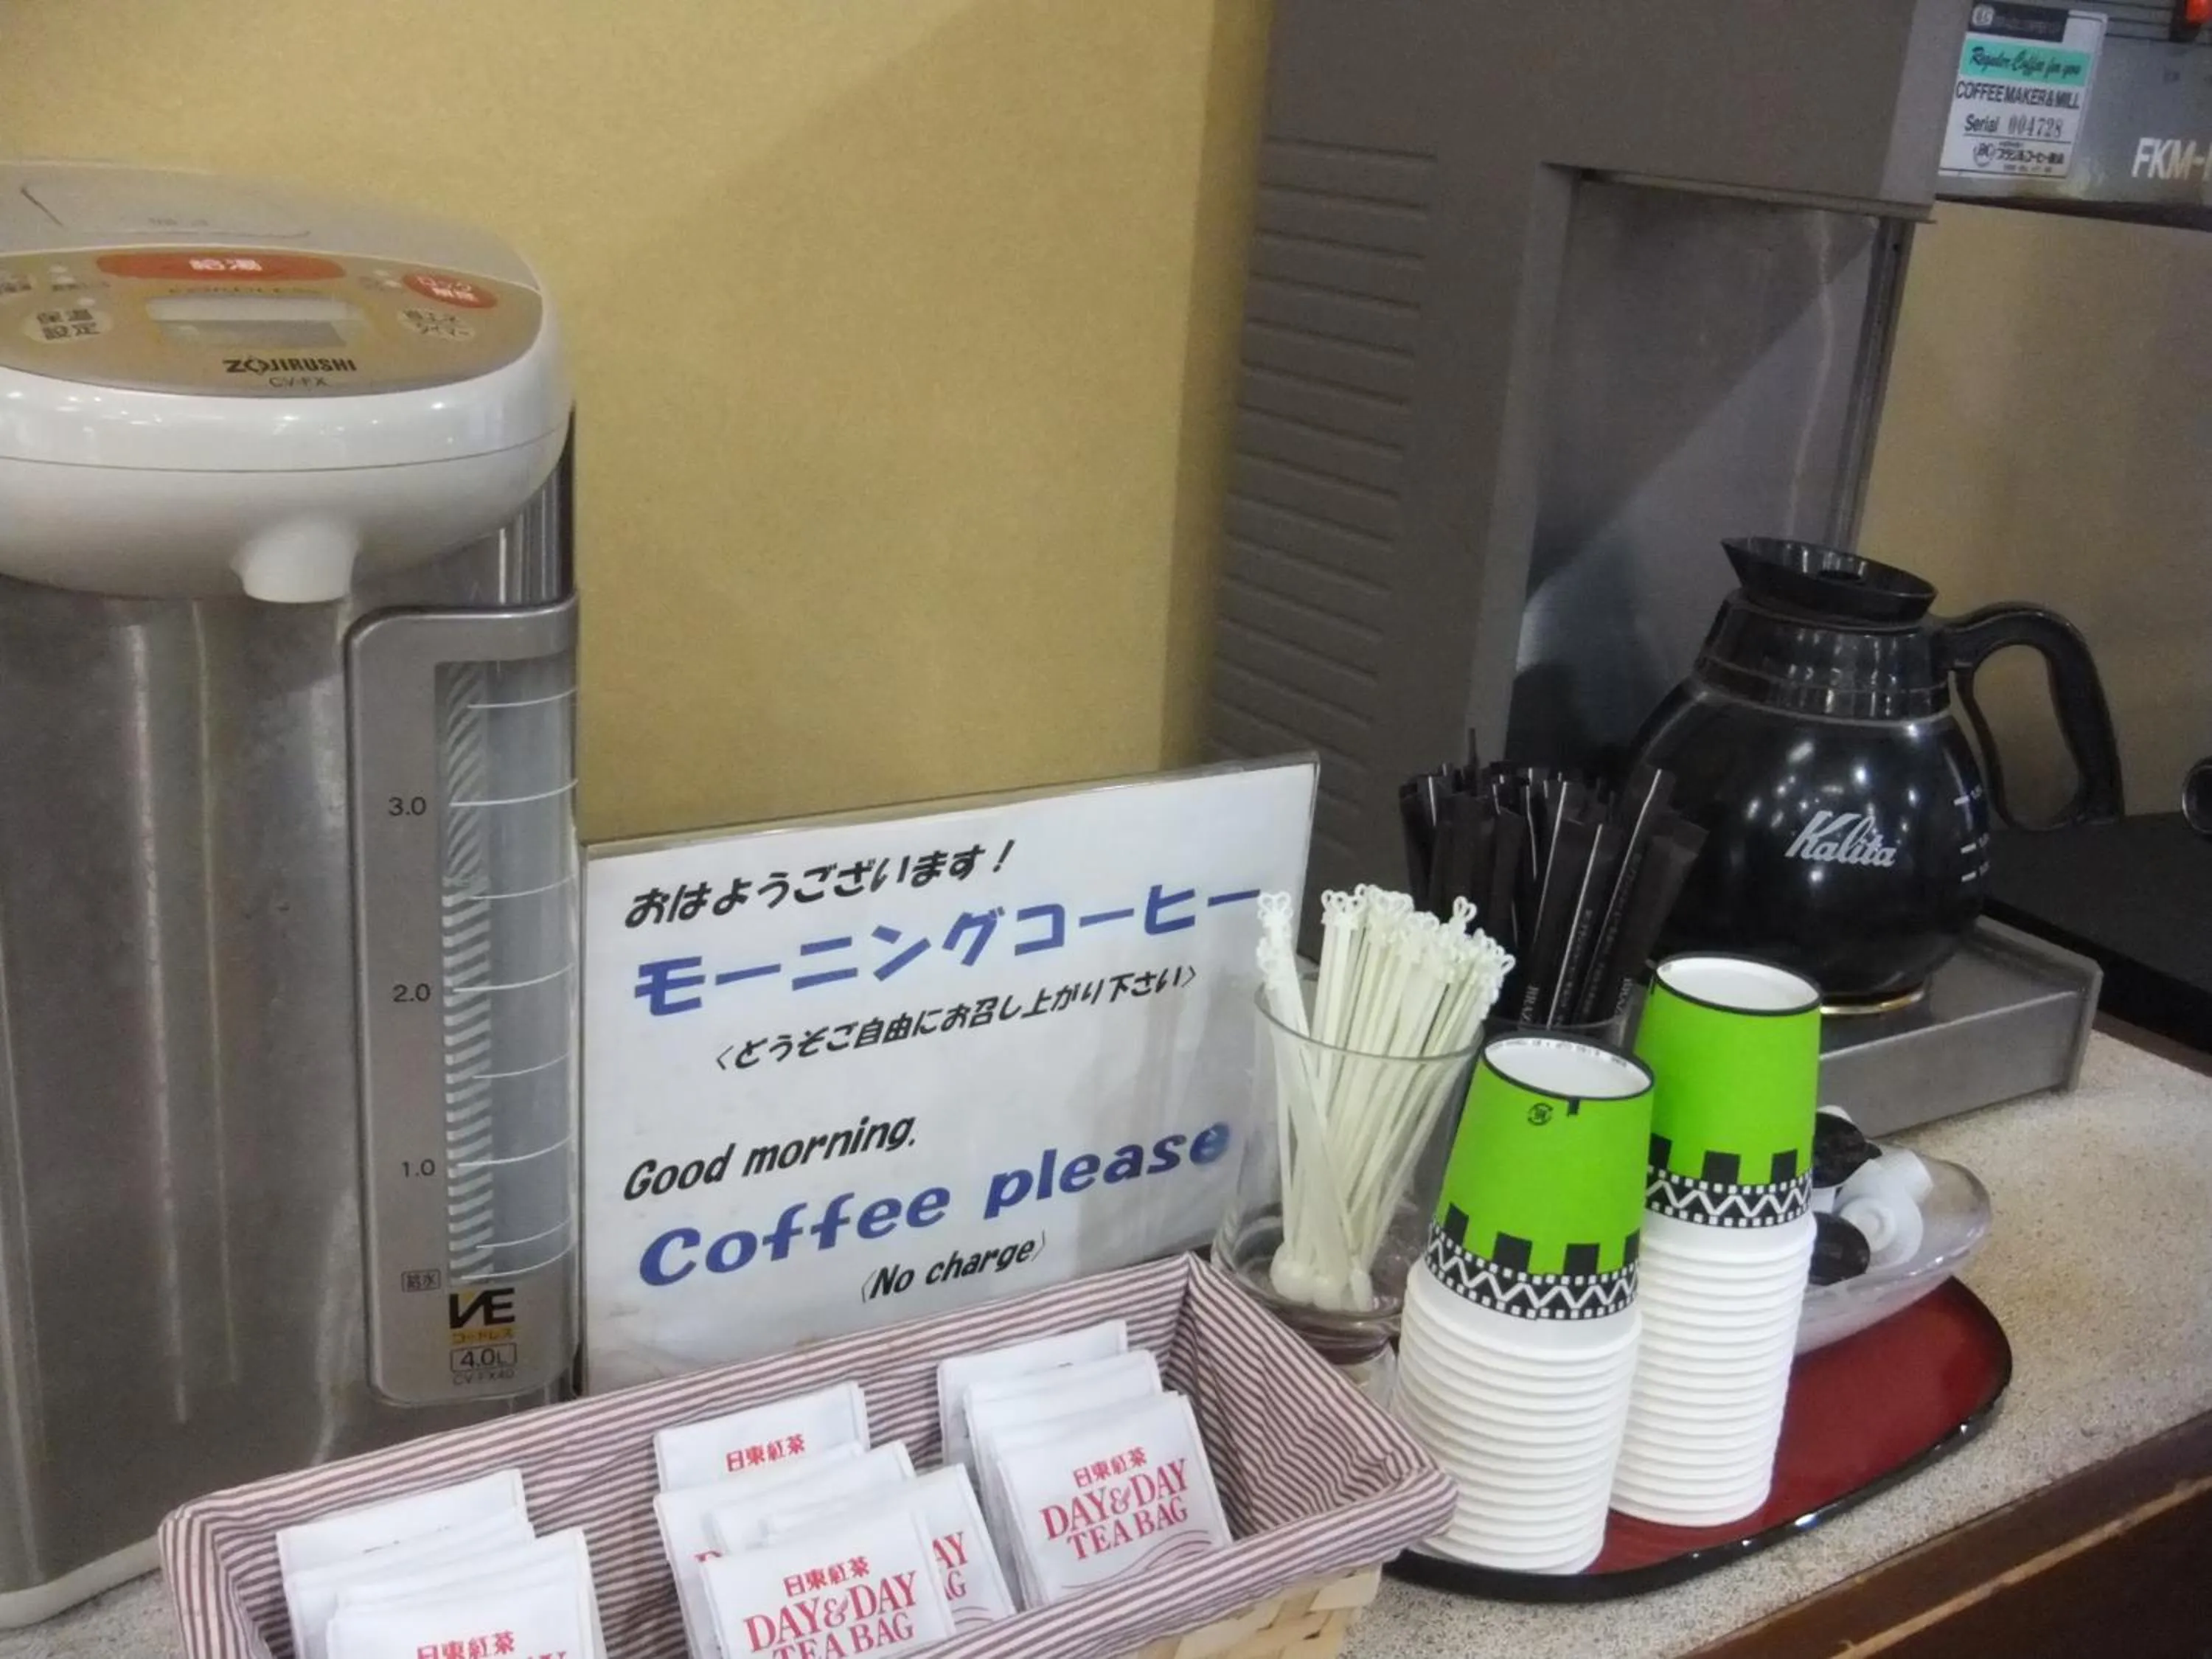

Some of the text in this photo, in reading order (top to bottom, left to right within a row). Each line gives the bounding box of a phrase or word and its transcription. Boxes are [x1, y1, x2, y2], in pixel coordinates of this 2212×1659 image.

[1955, 80, 2005, 102] COFFEE
[1964, 114, 2001, 133] Serial
[2131, 136, 2212, 181] FKM-
[223, 357, 358, 375] ZOJIRUSHI
[388, 796, 427, 817] 3.0
[1784, 810, 1898, 868] Kalita
[634, 884, 1262, 1017] モーニングコーヒー
[393, 983, 431, 1003] 2.0
[401, 1158, 435, 1179] 1.0
[623, 1115, 917, 1201] Good morning.
[639, 1121, 1231, 1287] Coffee please
[726, 1433, 805, 1472] 日東紅茶
[1073, 1446, 1147, 1488] 日東紅茶
[1066, 1495, 1189, 1560] TEA BAG
[783, 1555, 870, 1599] 日東紅茶
[847, 1610, 914, 1655] BAG
